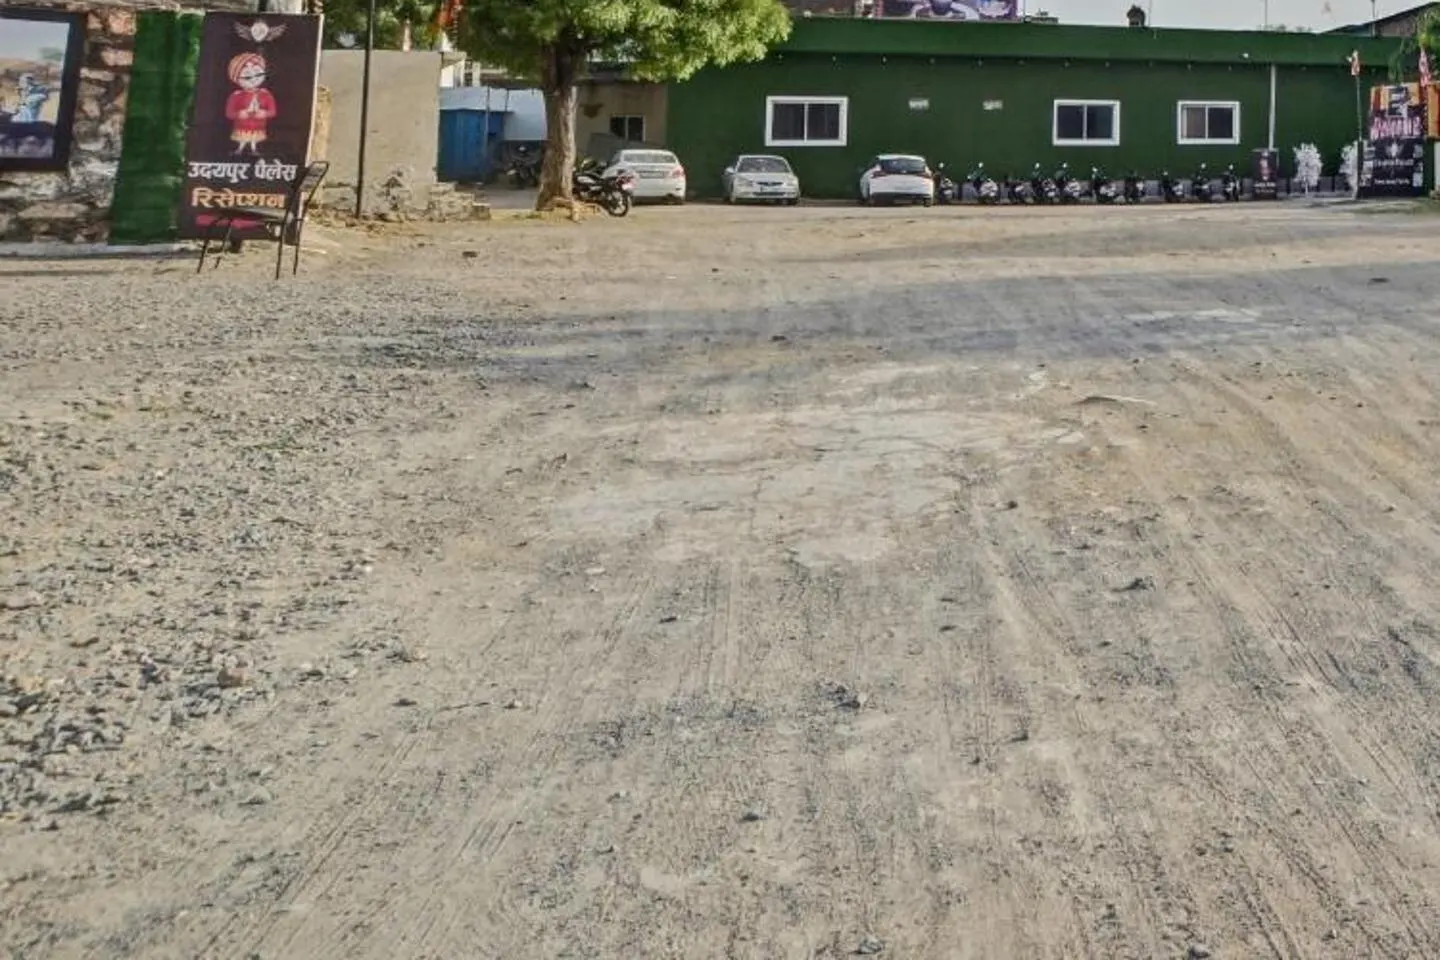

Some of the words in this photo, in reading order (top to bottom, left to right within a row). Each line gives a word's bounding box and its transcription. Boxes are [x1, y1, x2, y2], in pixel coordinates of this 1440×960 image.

[188, 161, 250, 183] उदयपुर
[254, 158, 298, 181] पैलेस
[191, 187, 285, 208] रिसेप्शन
